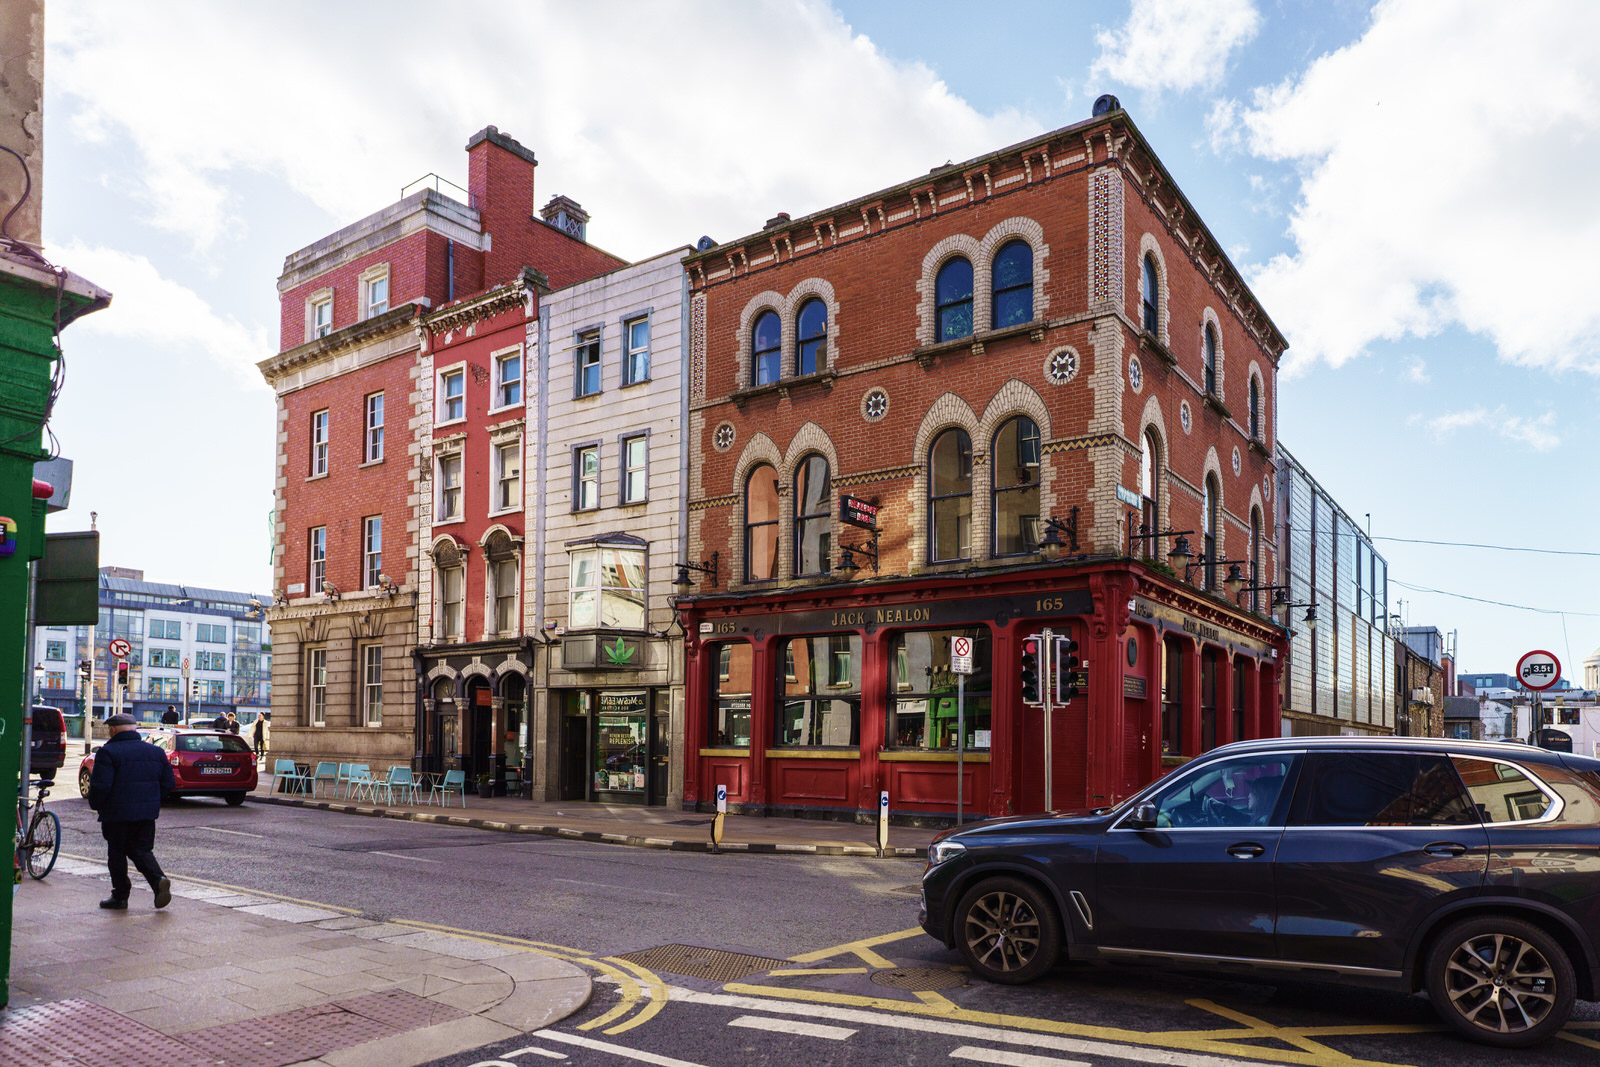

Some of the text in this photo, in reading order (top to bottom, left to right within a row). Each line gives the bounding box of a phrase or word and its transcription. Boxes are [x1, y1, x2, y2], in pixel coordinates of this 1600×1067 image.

[1036, 598, 1064, 612] 165
[831, 607, 931, 627] JACK NEALON
[716, 622, 737, 634] 165
